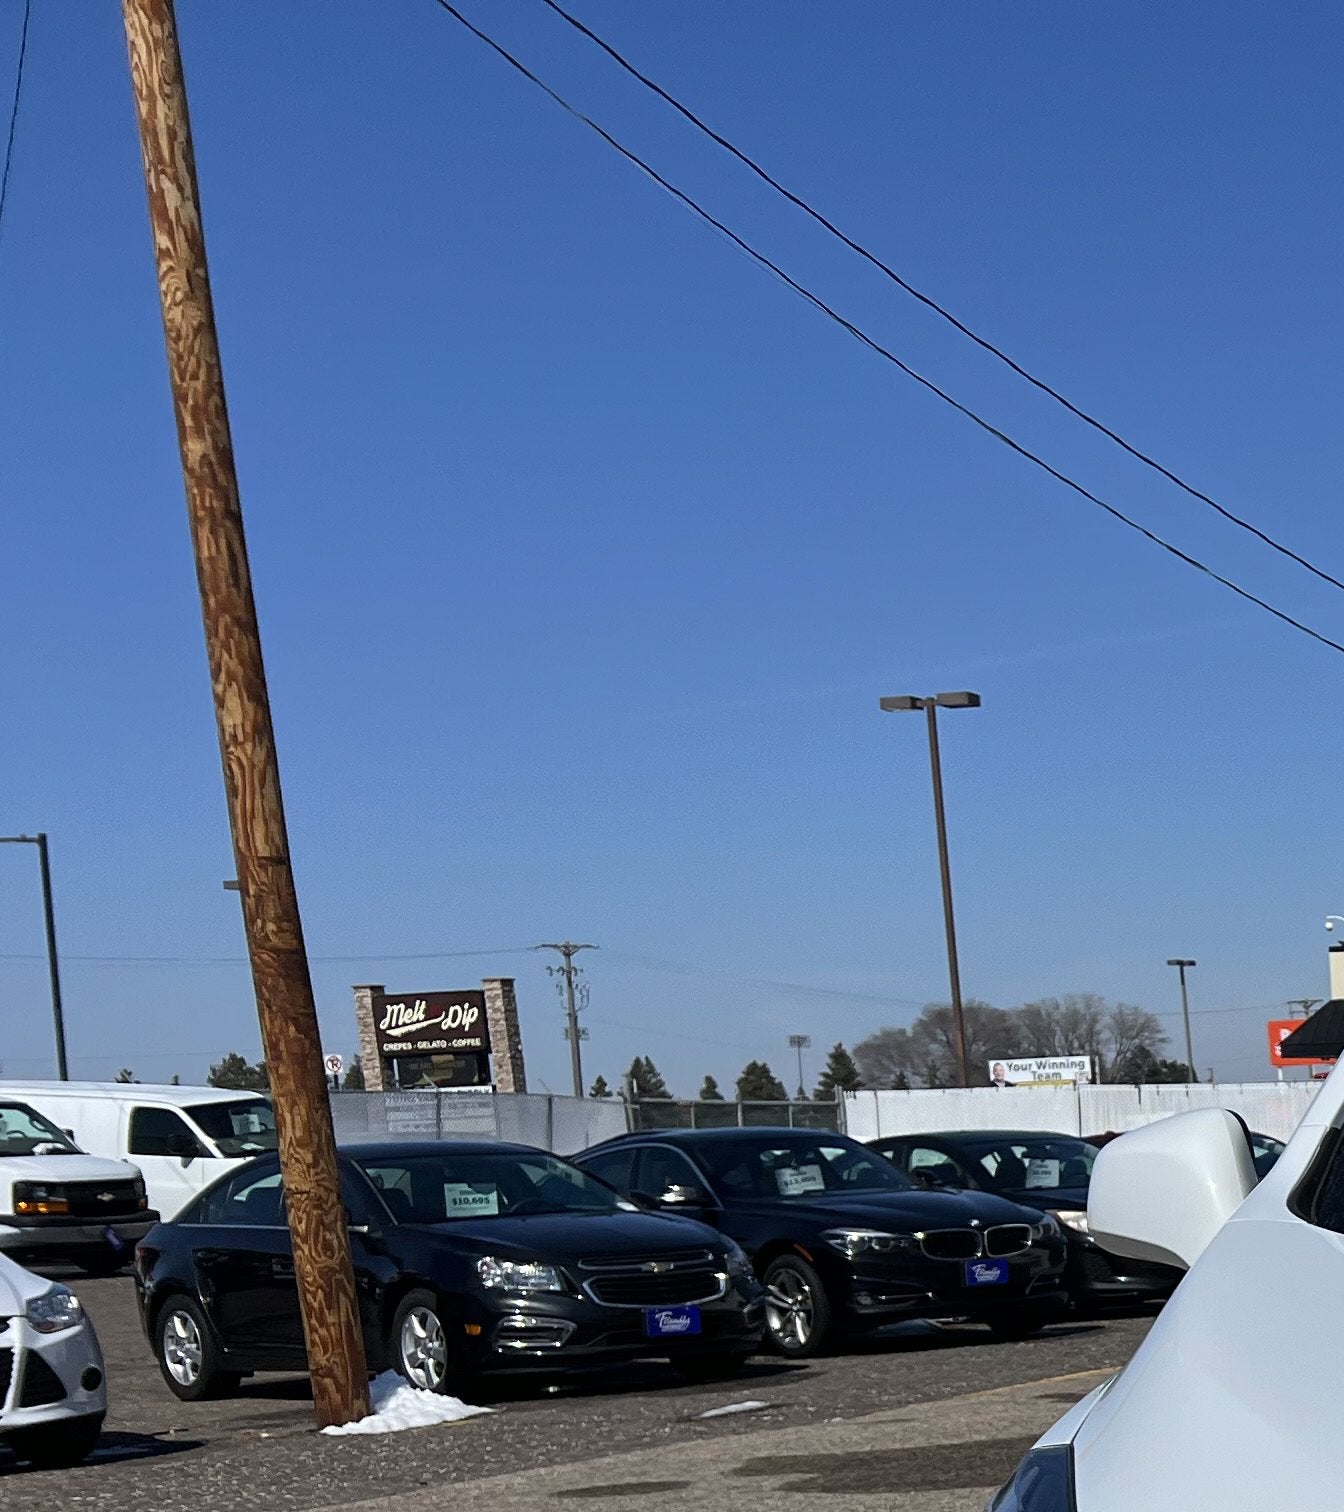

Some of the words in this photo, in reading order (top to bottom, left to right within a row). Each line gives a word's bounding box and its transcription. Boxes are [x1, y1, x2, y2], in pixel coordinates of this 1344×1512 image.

[379, 999, 427, 1030] Melt
[441, 1002, 479, 1032] Dip
[417, 1039, 447, 1049] GELATO
[452, 1037, 481, 1047] COFFEE
[1006, 1061, 1032, 1073] Your
[1034, 1059, 1085, 1070] Winning
[1031, 1070, 1062, 1080] Team
